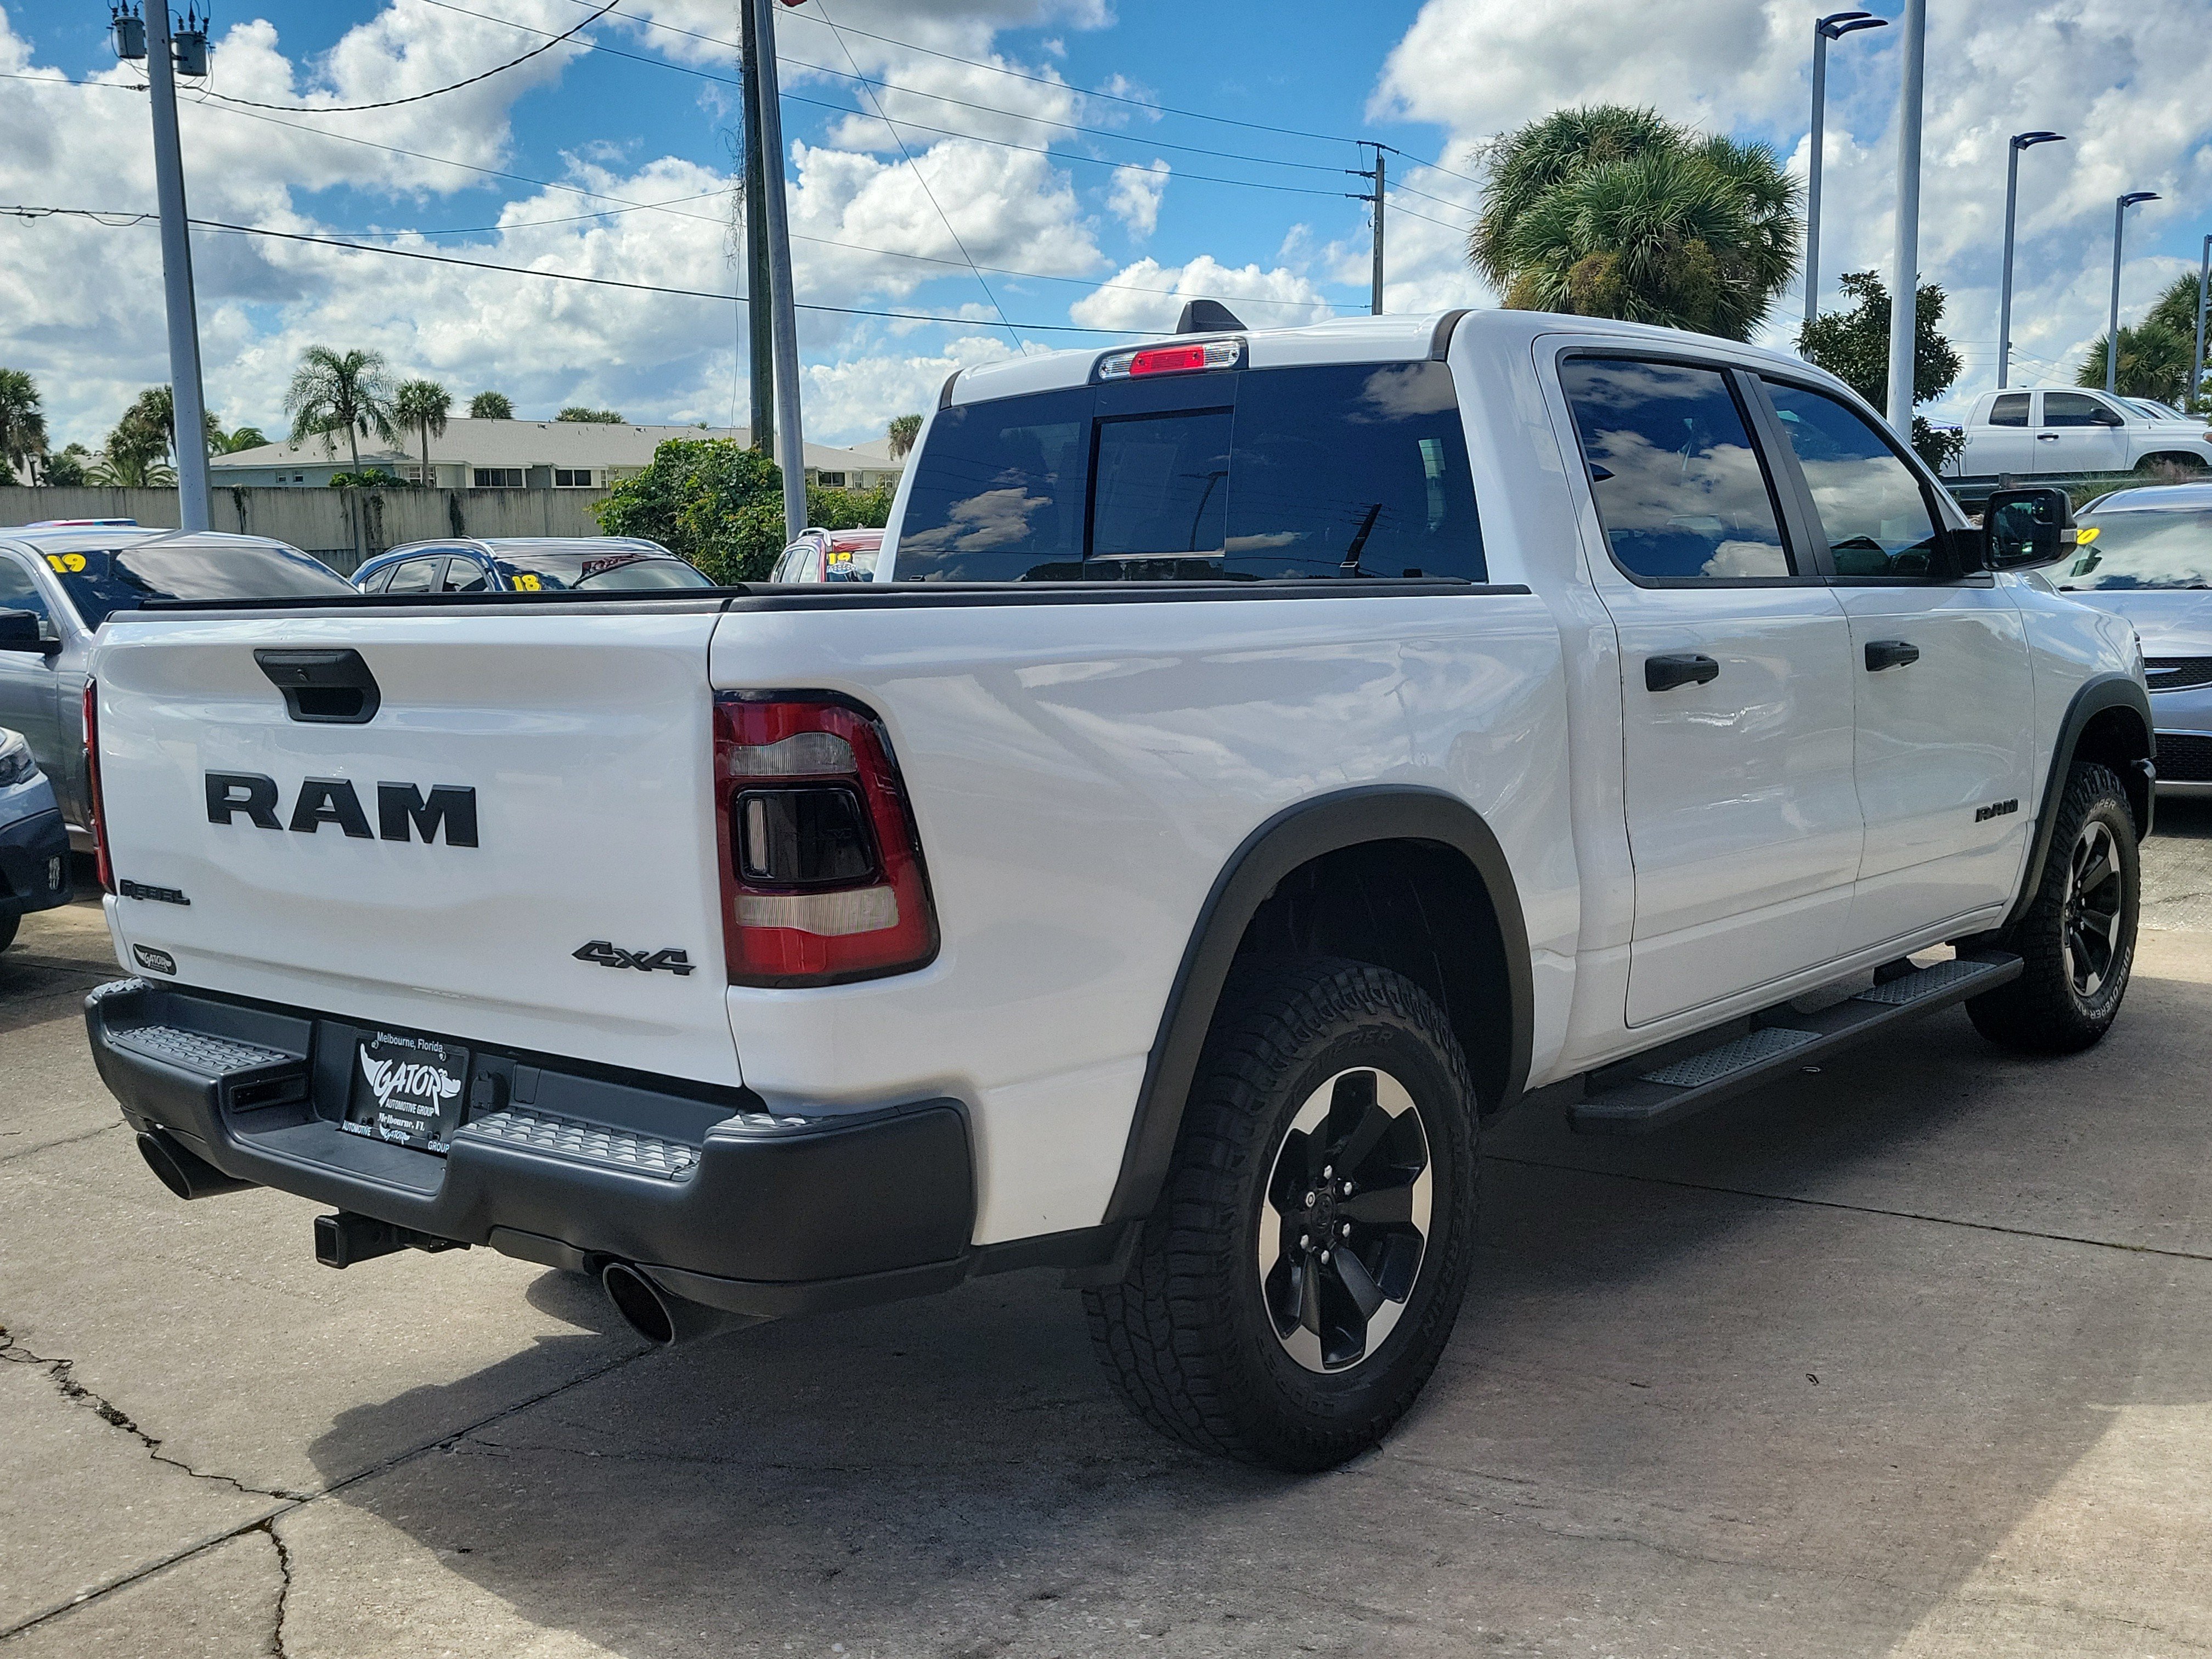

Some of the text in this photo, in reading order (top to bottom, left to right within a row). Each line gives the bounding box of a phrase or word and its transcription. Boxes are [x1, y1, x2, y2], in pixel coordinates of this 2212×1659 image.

[46, 553, 86, 573] 19
[828, 552, 851, 565] 19
[512, 574, 540, 591] 18
[205, 769, 479, 848] RAM
[1974, 798, 2018, 823] RAM
[377, 1031, 443, 1053] Melbourne, Florida
[374, 1059, 441, 1116] GATOR
[385, 1098, 435, 1117] AUTOMOTIVE GROUP
[341, 1120, 372, 1137] AUTOMOTIVE
[427, 1141, 450, 1153] GROUP
